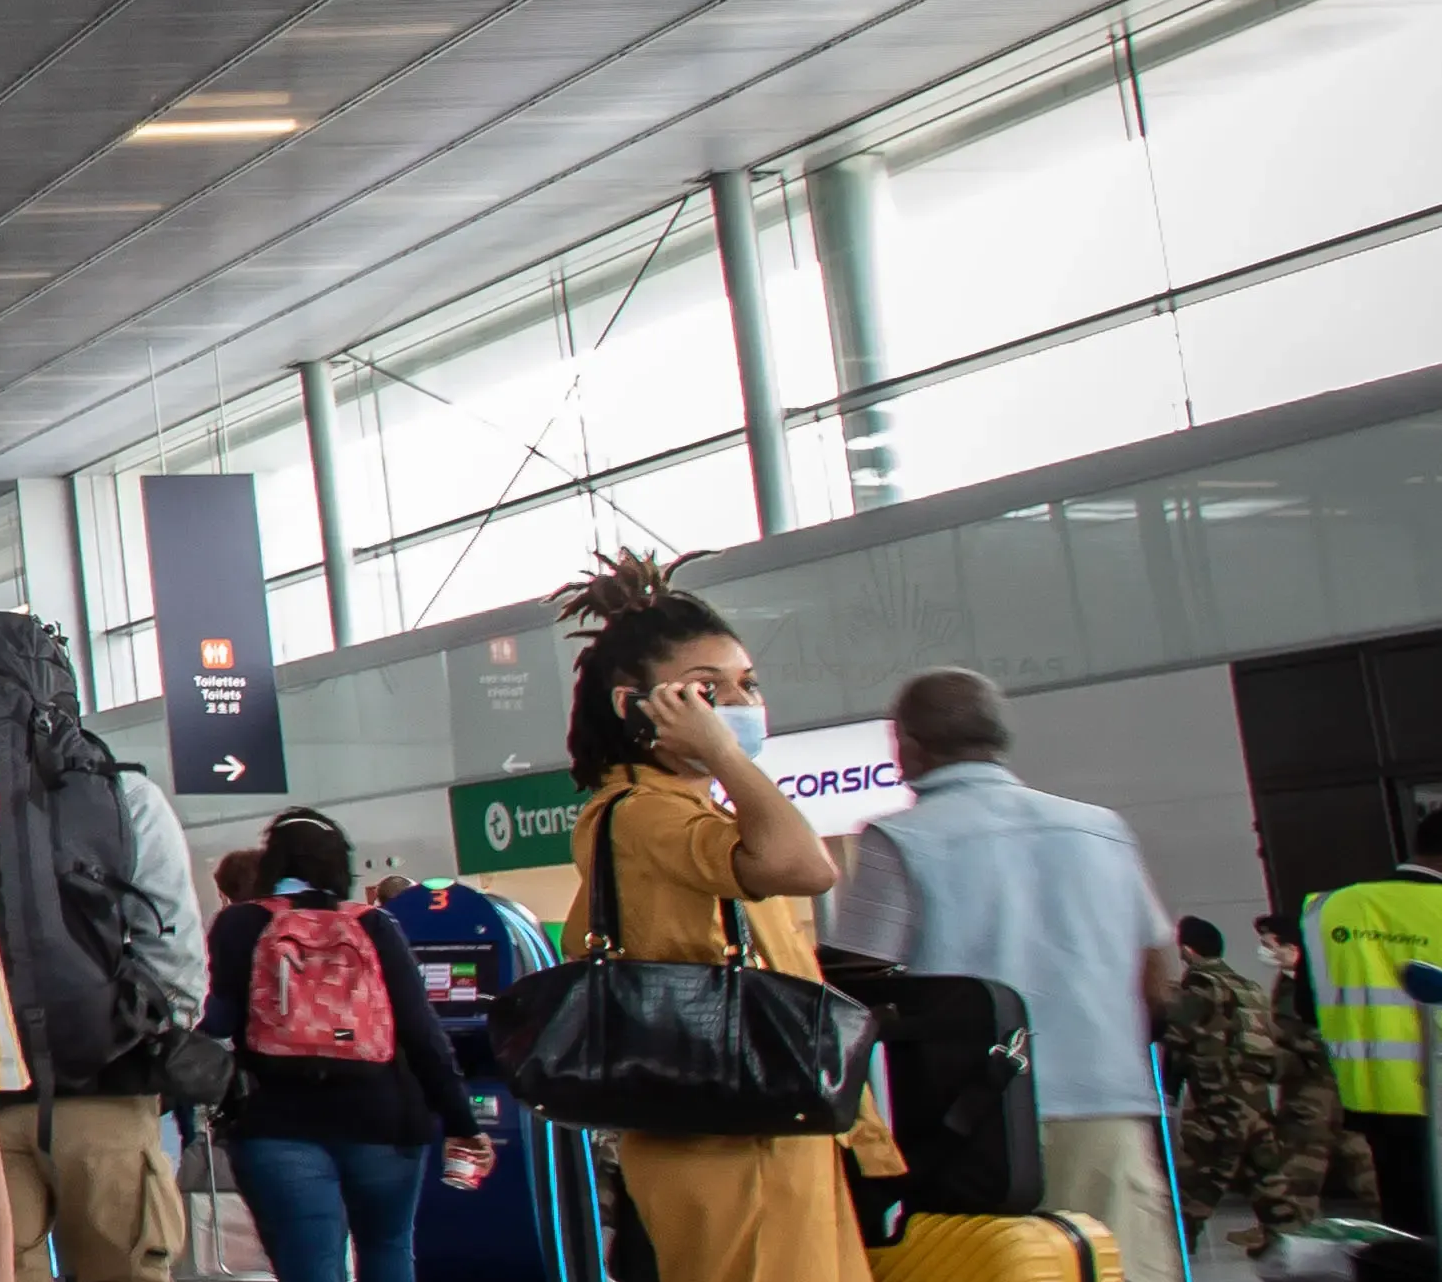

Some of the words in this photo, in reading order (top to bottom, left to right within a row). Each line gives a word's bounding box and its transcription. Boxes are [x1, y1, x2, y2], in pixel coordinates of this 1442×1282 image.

[193, 674, 247, 688] Toilettes
[200, 688, 242, 701] Toilets
[776, 762, 903, 800] CORSIC
[428, 889, 450, 911] 3
